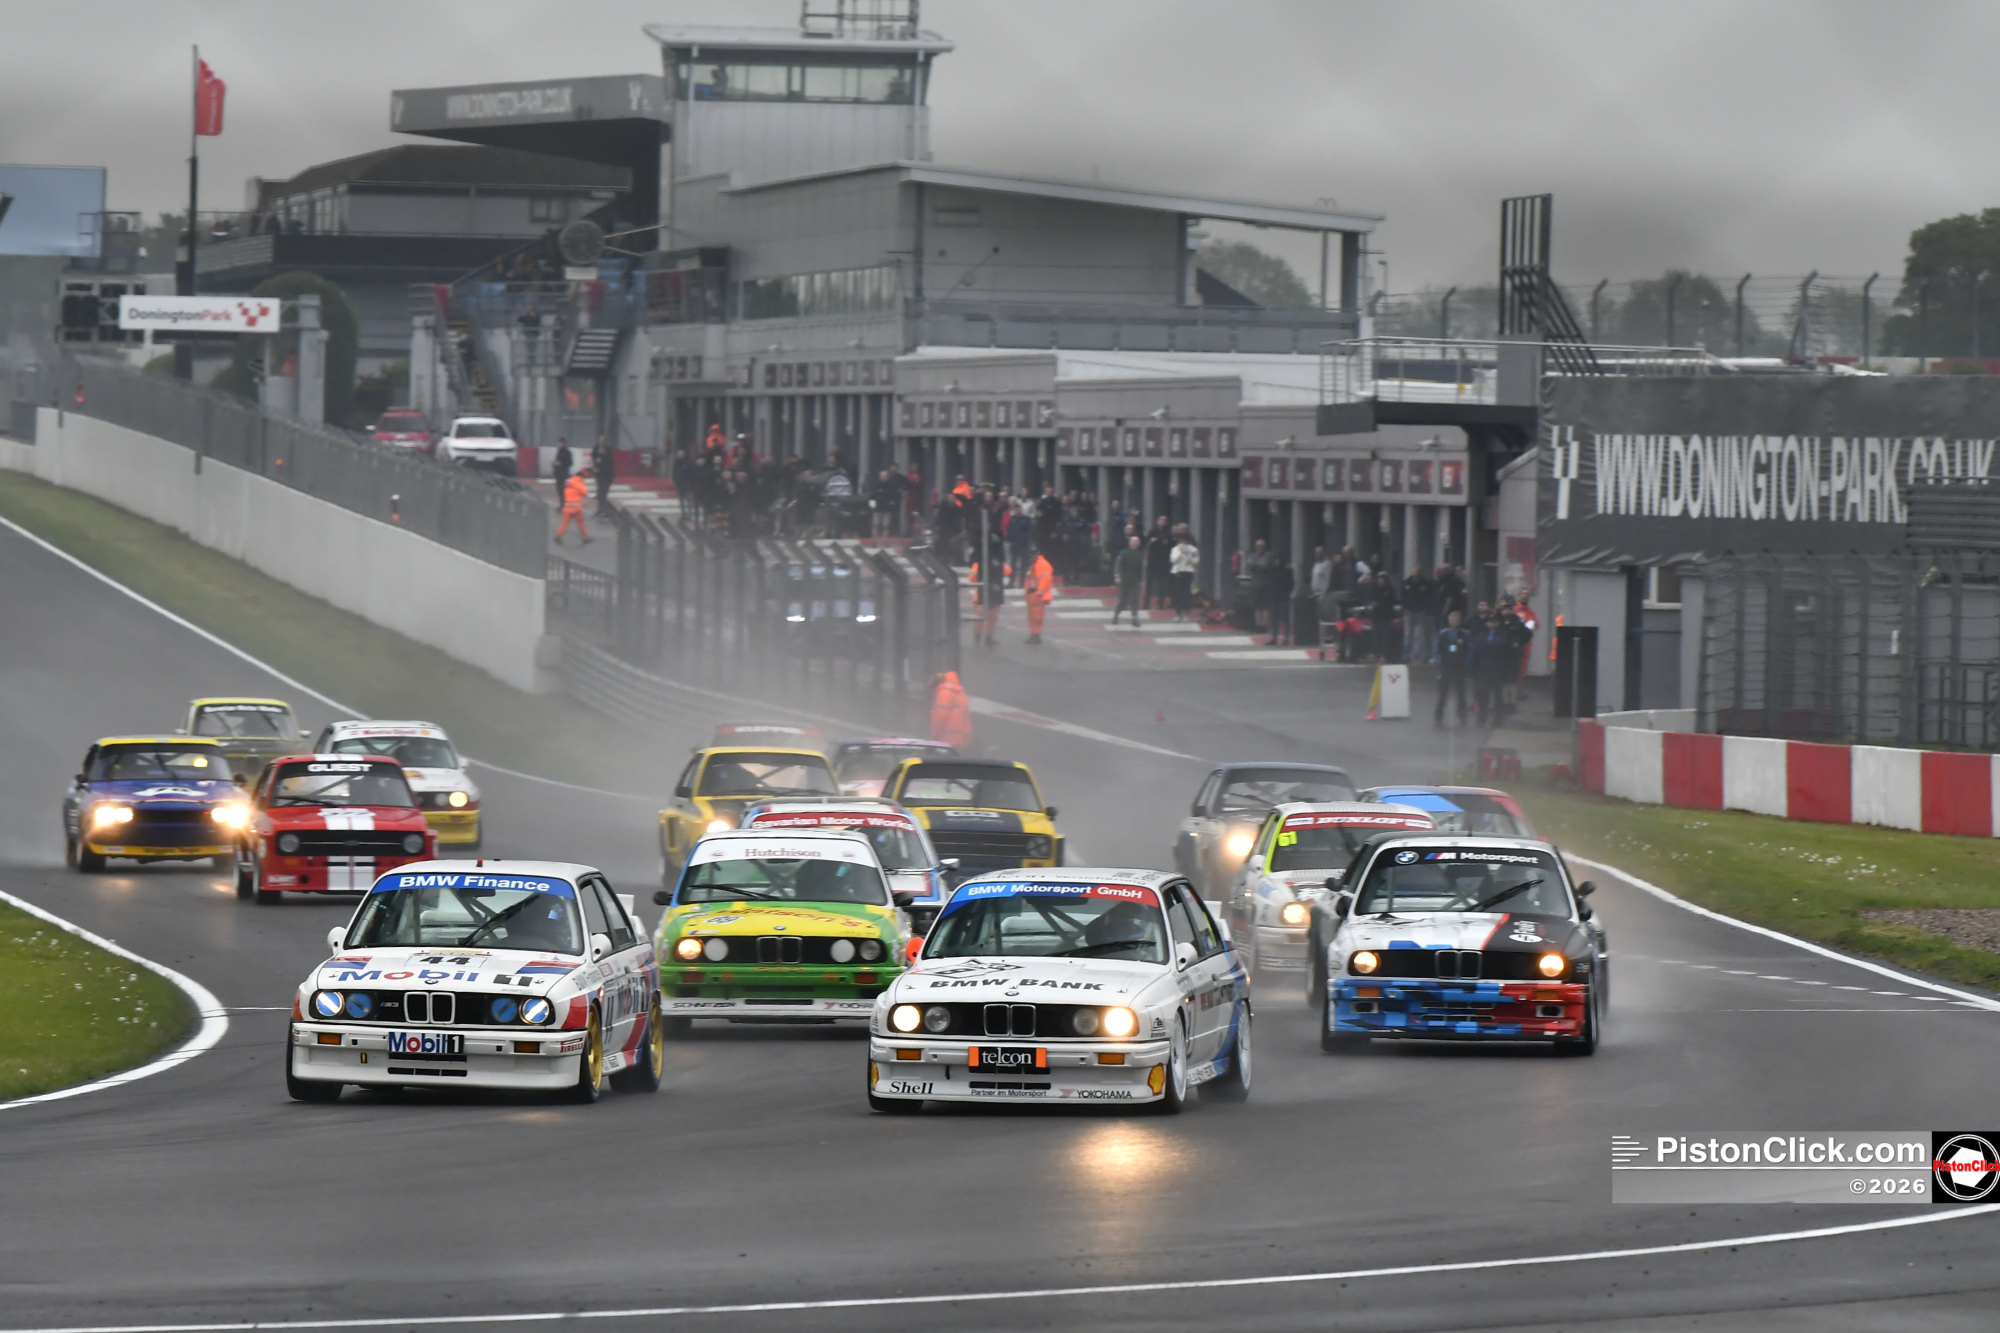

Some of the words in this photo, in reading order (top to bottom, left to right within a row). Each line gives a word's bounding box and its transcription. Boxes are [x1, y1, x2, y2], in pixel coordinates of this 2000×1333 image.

[128, 308, 232, 323] DoningtonPark
[1595, 434, 1995, 524] WWW.DONINGTON-PARK.COUK
[307, 763, 373, 772] GUEST
[752, 817, 818, 830] Bavarian
[820, 816, 864, 826] Motor
[867, 817, 915, 831] Works
[1315, 816, 1404, 825] DUNLOP
[745, 848, 821, 858] Hutchison
[1460, 852, 1539, 864] Motorsport
[399, 875, 460, 888] BMW
[463, 876, 550, 892] Finance
[968, 884, 1006, 896] BMW
[1010, 884, 1092, 895] Motorsport
[1096, 886, 1143, 899] GmbH
[420, 955, 471, 966] 44
[338, 969, 480, 982] Mobil
[929, 979, 1010, 988] BMW
[1019, 978, 1105, 991] BANK
[388, 1032, 447, 1053] Mobil
[982, 1048, 1032, 1064] telcon
[889, 1081, 934, 1095] Shell
[971, 1089, 996, 1097] Partner
[998, 1089, 1006, 1097] im
[1008, 1089, 1047, 1098] Motorsport
[1076, 1089, 1133, 1099] YOKOHAMA
